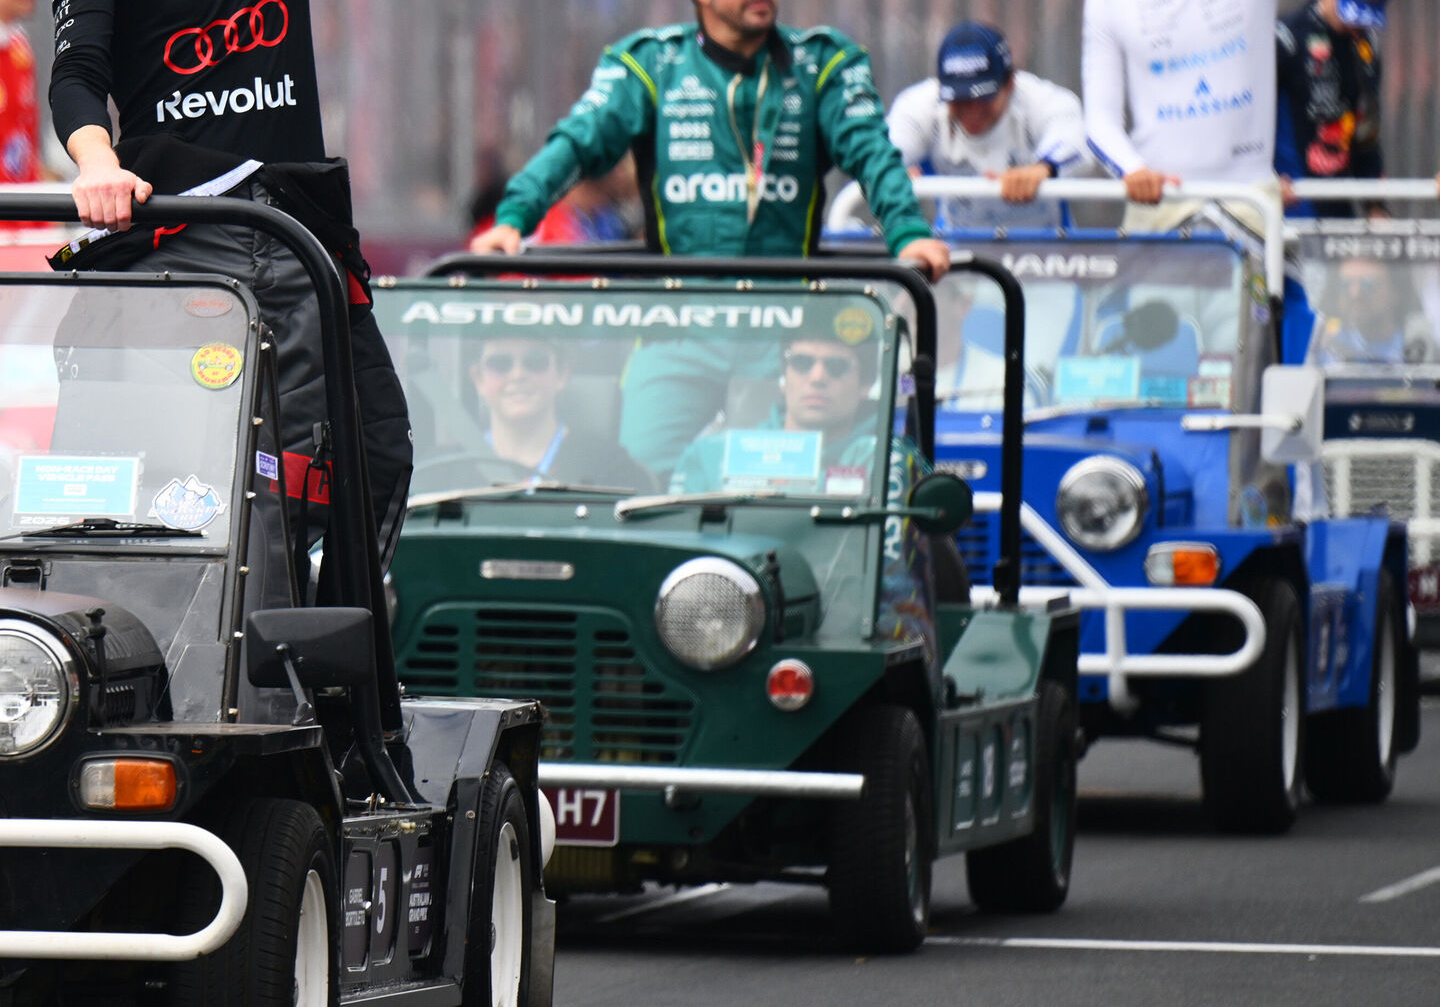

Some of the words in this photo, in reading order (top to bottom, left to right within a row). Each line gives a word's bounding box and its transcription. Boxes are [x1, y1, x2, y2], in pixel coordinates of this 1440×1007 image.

[156, 73, 297, 123] Revolut
[1002, 253, 1119, 278] IAMS
[402, 301, 584, 326] ASTON
[593, 303, 804, 328] MARTIN
[557, 789, 607, 827] H7
[376, 867, 388, 934] 5
